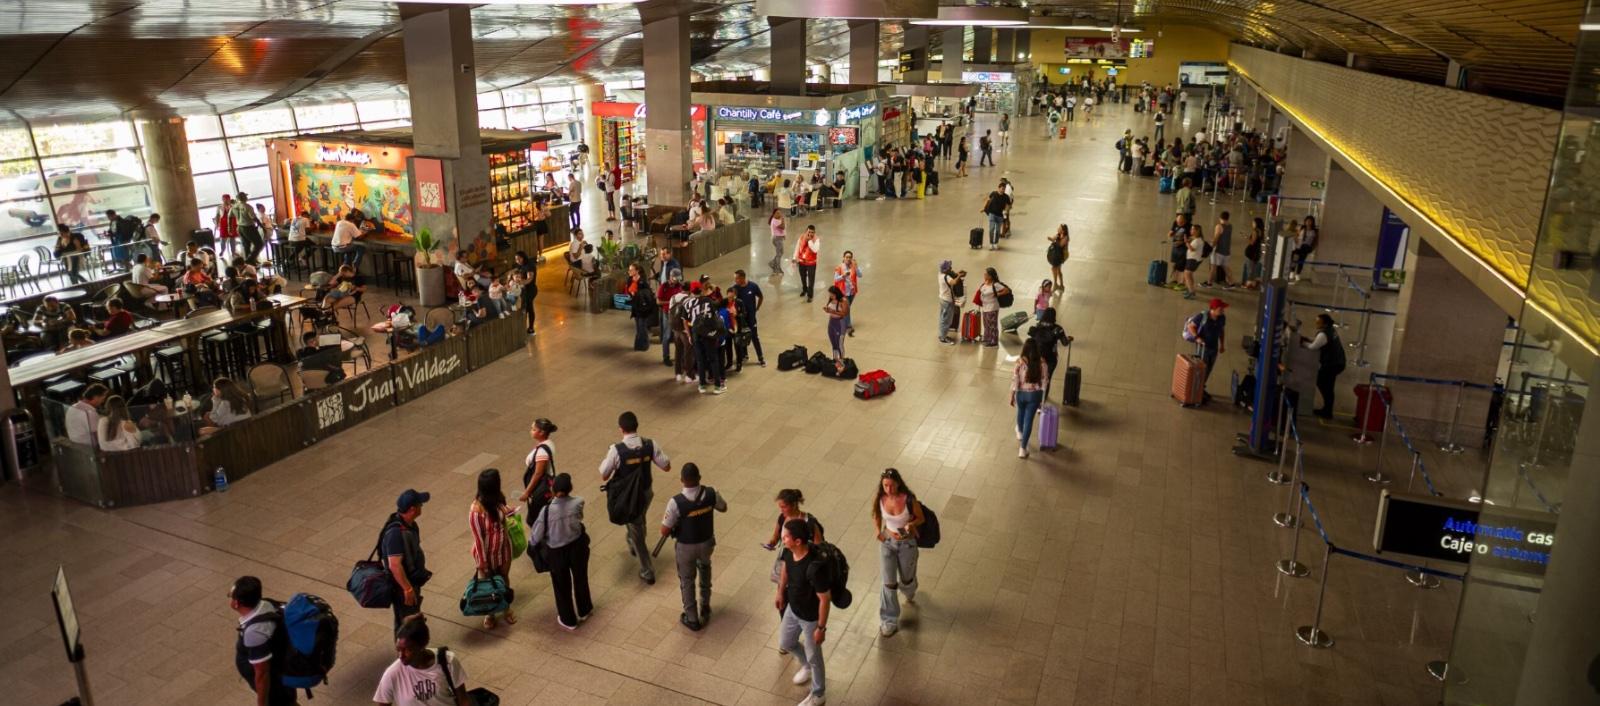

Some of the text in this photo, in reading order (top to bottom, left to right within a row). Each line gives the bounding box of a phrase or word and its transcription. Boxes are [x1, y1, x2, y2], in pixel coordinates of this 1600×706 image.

[719, 107, 758, 119] Chantilly
[760, 109, 781, 119] Café
[348, 354, 461, 412] Juan Valdez
[1527, 532, 1553, 546] cas
